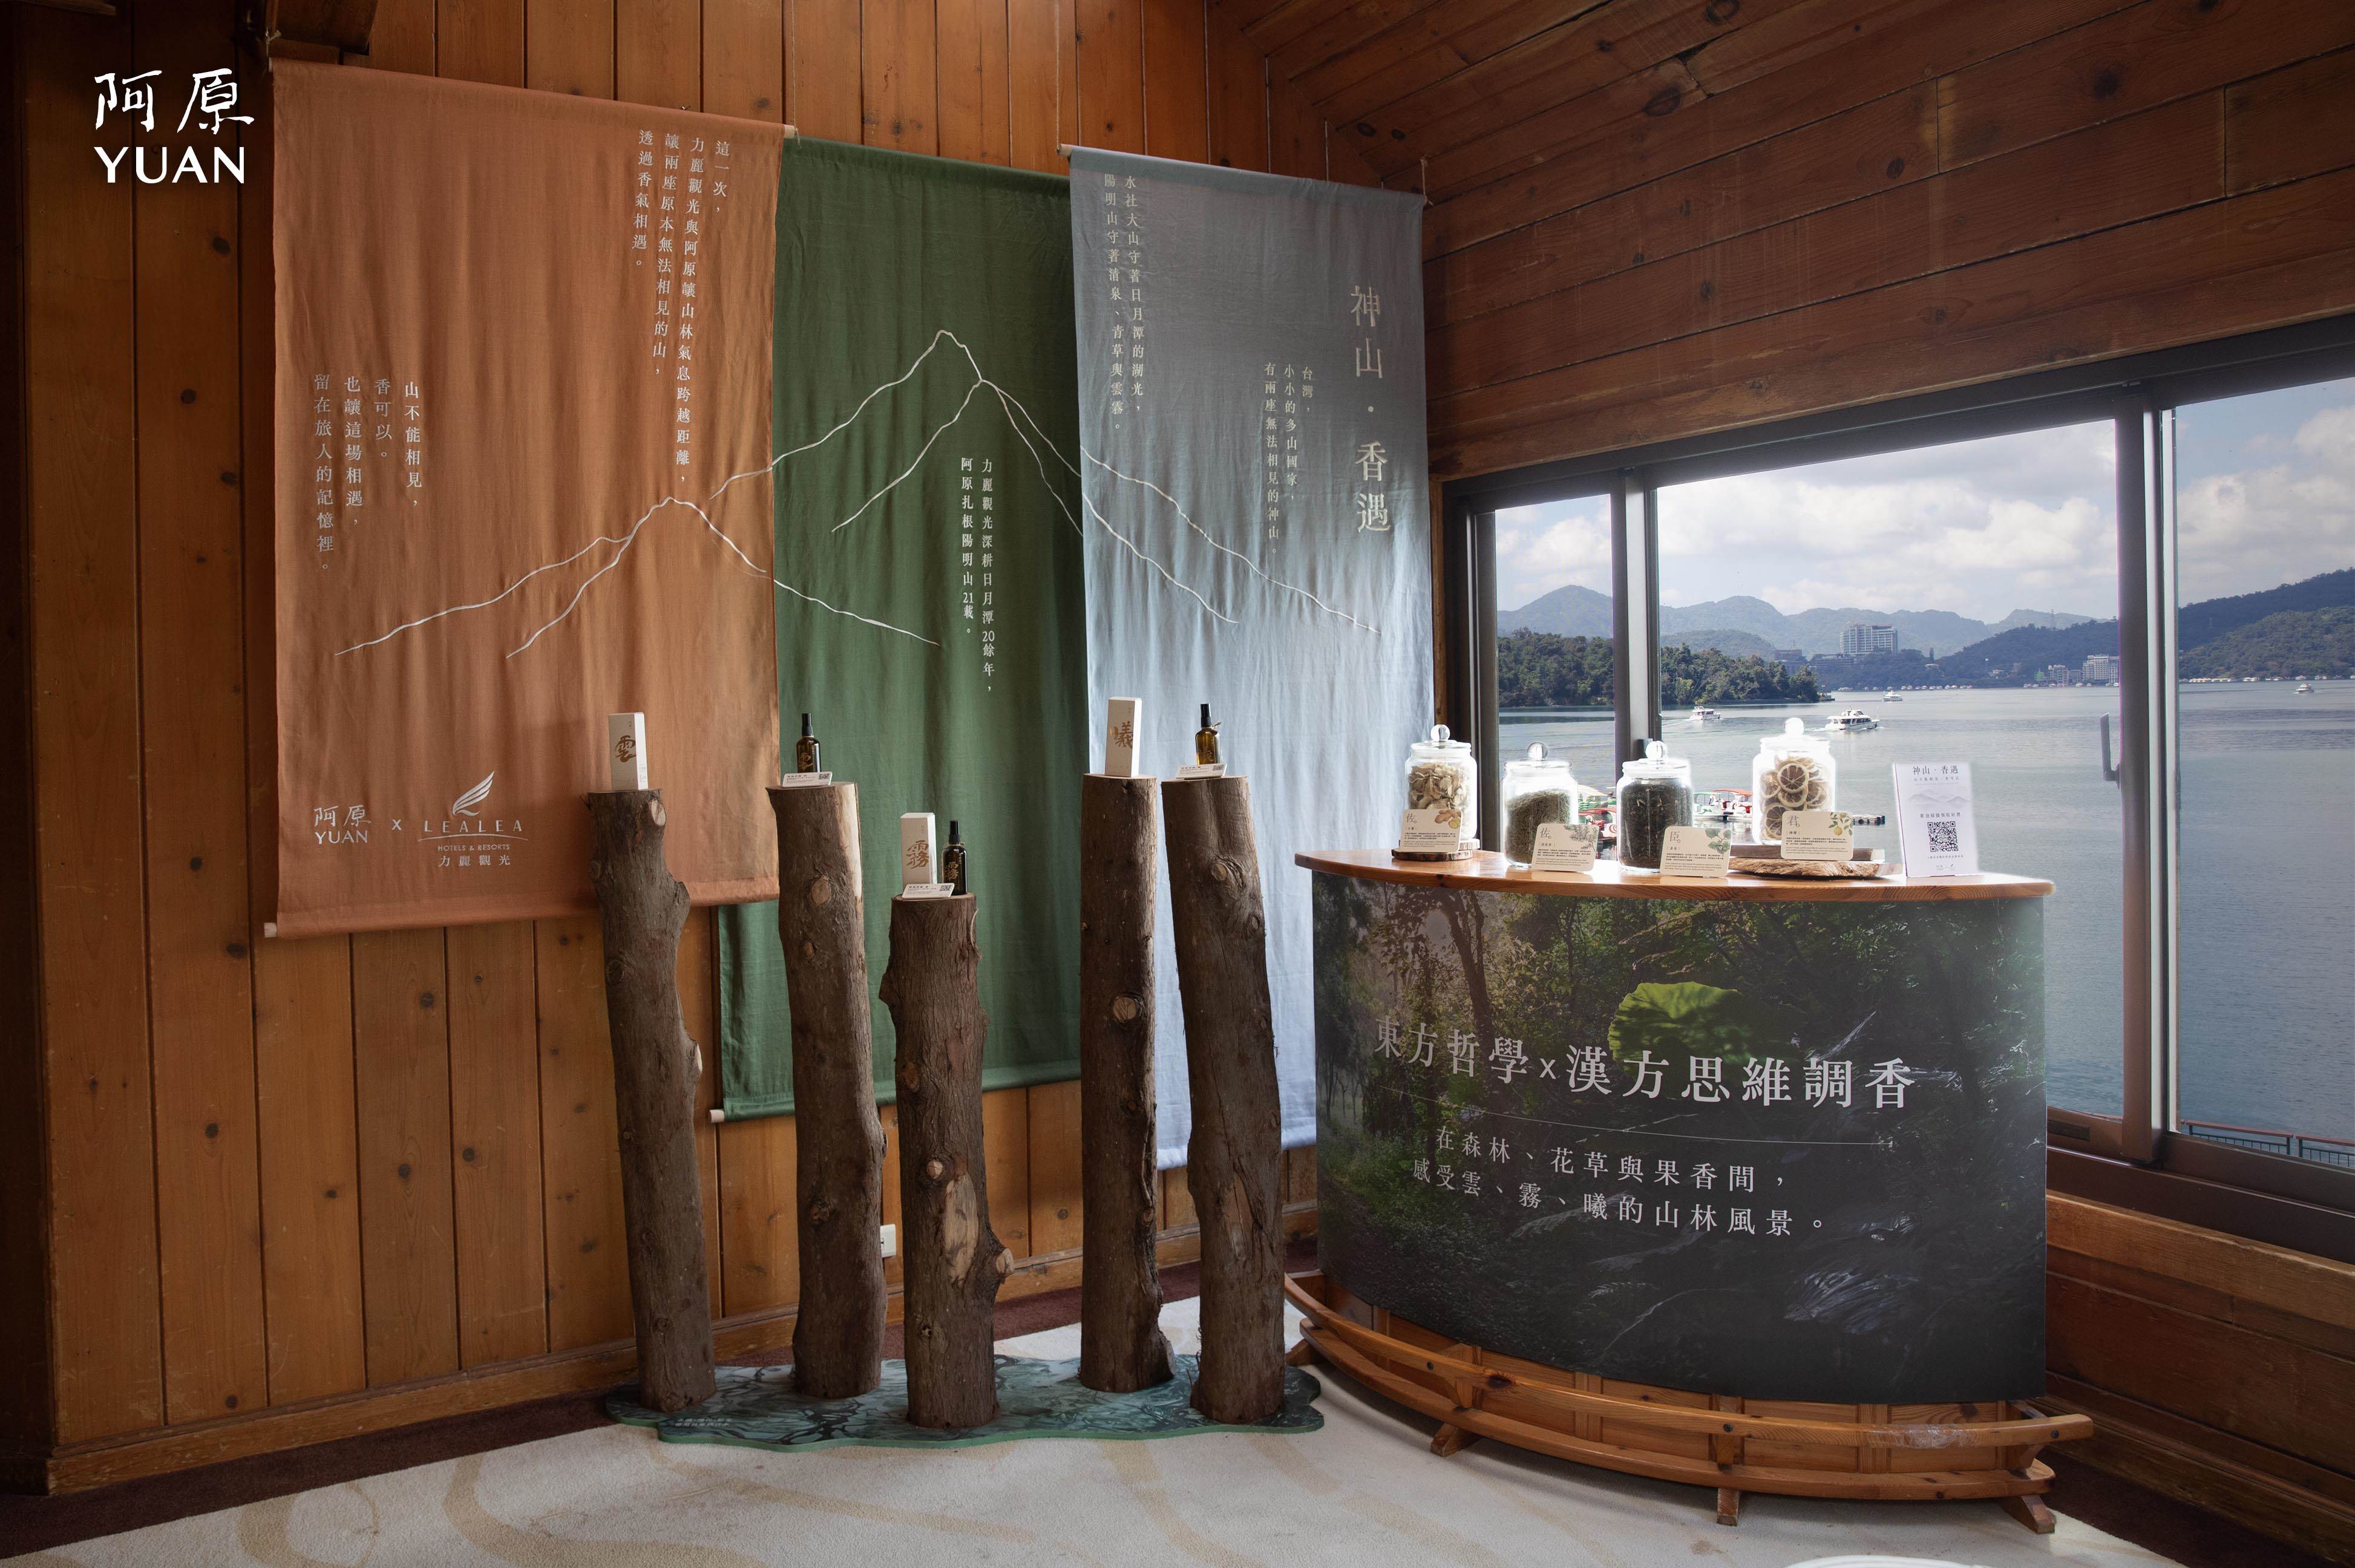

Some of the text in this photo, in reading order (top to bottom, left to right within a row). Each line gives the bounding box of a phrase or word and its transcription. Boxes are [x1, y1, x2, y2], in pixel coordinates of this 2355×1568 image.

[632, 129, 653, 266] 透過香氣相遇。
[713, 140, 730, 212] 這一次，
[653, 133, 680, 374] 讓兩座原本無法相見的山，
[676, 137, 704, 482] 力麗觀光與阿原讓山林氣息跨越距離，
[1124, 175, 1145, 411] 水社大山守著日月潭的湖光，
[344, 376, 363, 525] 也讓這場相遇，
[374, 378, 392, 457] 香可以。
[404, 382, 422, 507] 山不能相見，
[1283, 364, 1297, 500] 小小的多山國家，
[1302, 366, 1314, 412] 台灣，
[314, 373, 334, 569] 留在旅人的記憶裡。
[1264, 362, 1279, 553] 有兩座無法相見的神山。
[981, 459, 995, 691] 力麗觀光深耕日月潭20餘年，
[313, 805, 372, 828] 阿原
[424, 820, 523, 833] LEALEA
[314, 830, 368, 845] YUAN
[439, 855, 511, 867] 力麗觀光
[906, 840, 929, 869] 霧
[1413, 1158, 1822, 1236] 感受雲、霧、曦的山林風景。
[1436, 1125, 1783, 1193] 在森林、花草與果香間，
